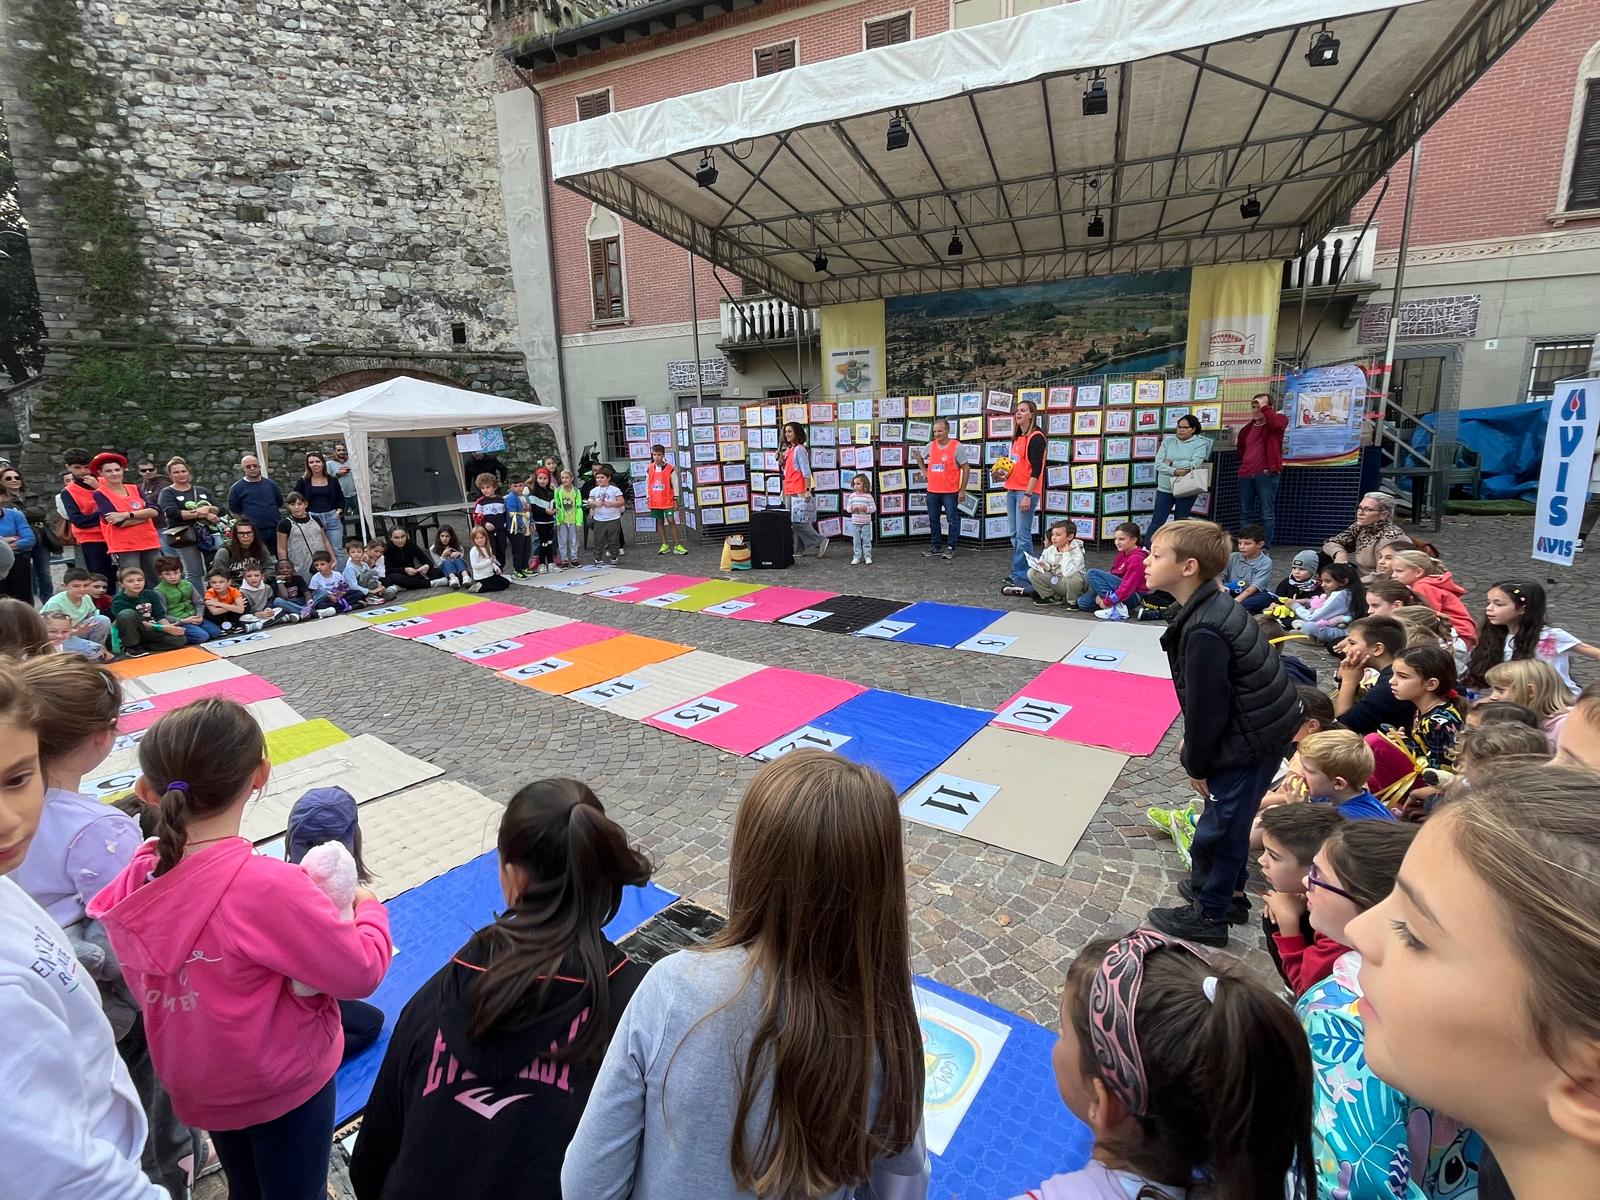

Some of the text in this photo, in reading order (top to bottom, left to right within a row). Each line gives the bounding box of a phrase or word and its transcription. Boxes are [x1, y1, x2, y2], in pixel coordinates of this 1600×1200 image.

[1549, 388, 1587, 527] AVIS
[1537, 536, 1574, 557] AVIS
[472, 643, 511, 655] 16
[976, 639, 1006, 647] 8
[1083, 653, 1118, 663] 9
[517, 661, 560, 676] 15
[591, 681, 636, 699] 14
[673, 702, 721, 723] 13
[1012, 702, 1061, 725] 10
[920, 784, 981, 817] 11
